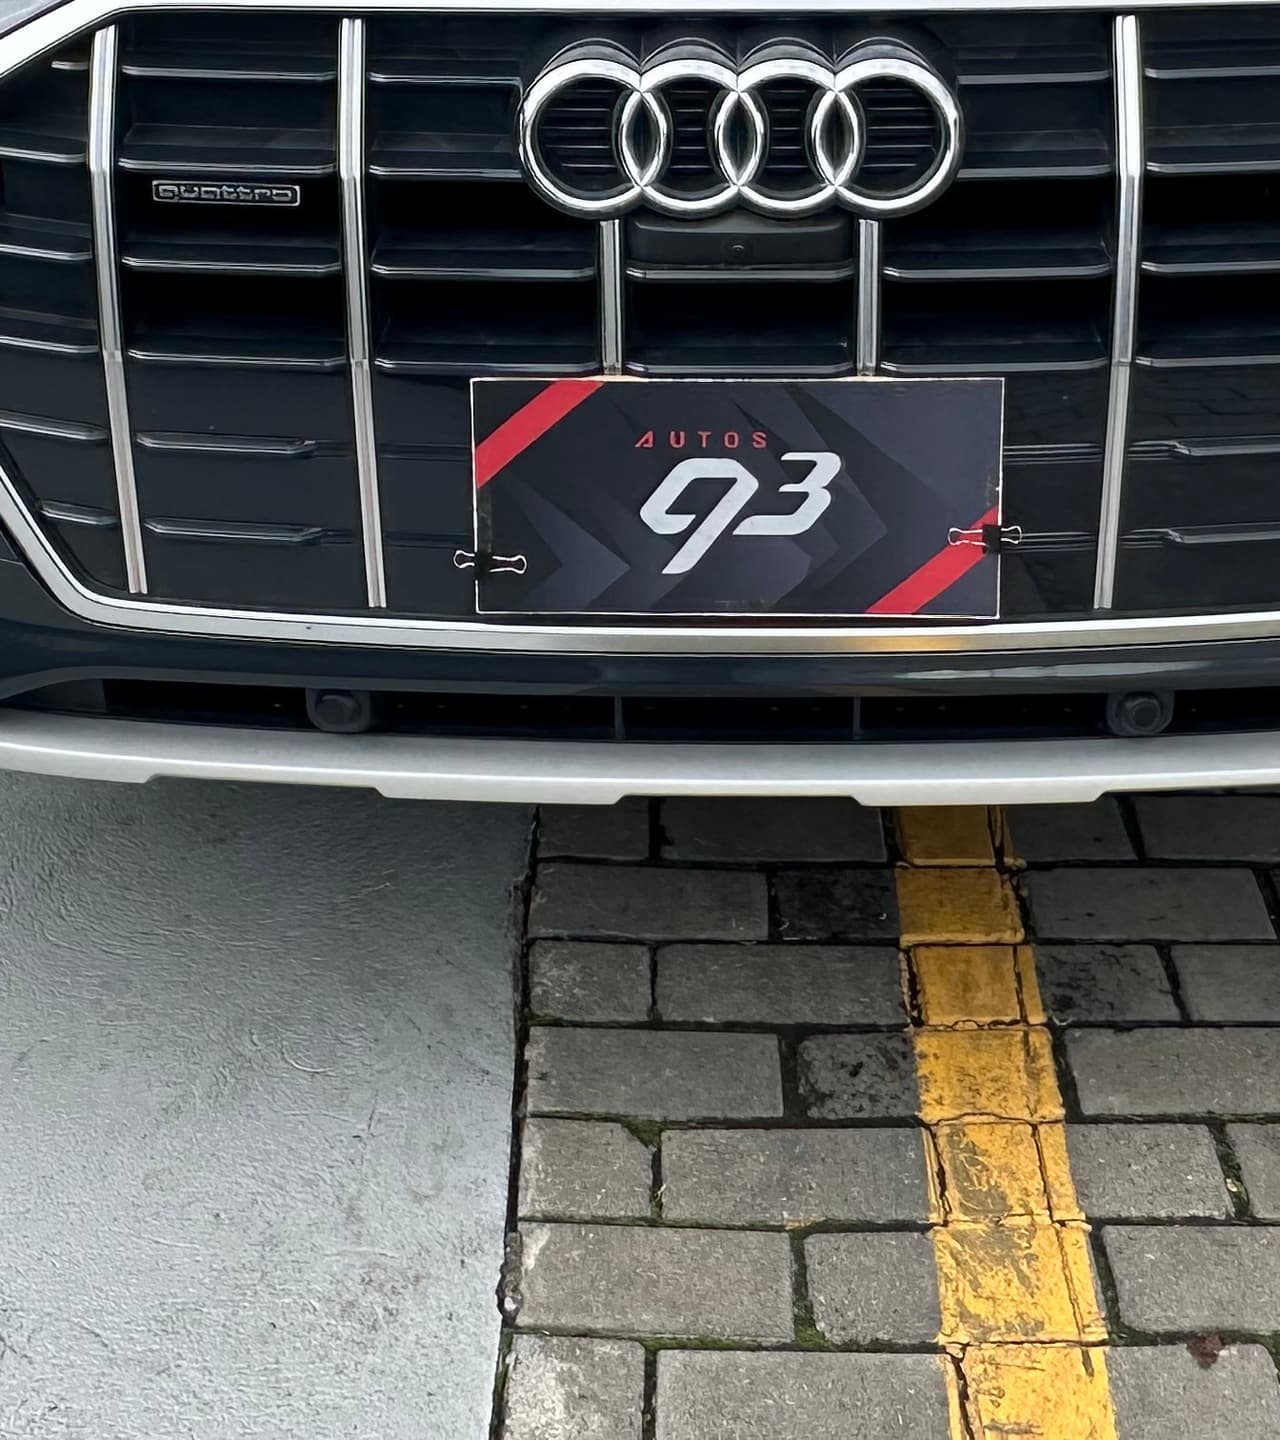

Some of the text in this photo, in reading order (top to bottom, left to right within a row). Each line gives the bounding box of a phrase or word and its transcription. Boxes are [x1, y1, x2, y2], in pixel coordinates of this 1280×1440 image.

[158, 184, 293, 203] quattro
[634, 430, 768, 449] AUTOS
[639, 451, 842, 575] 93
